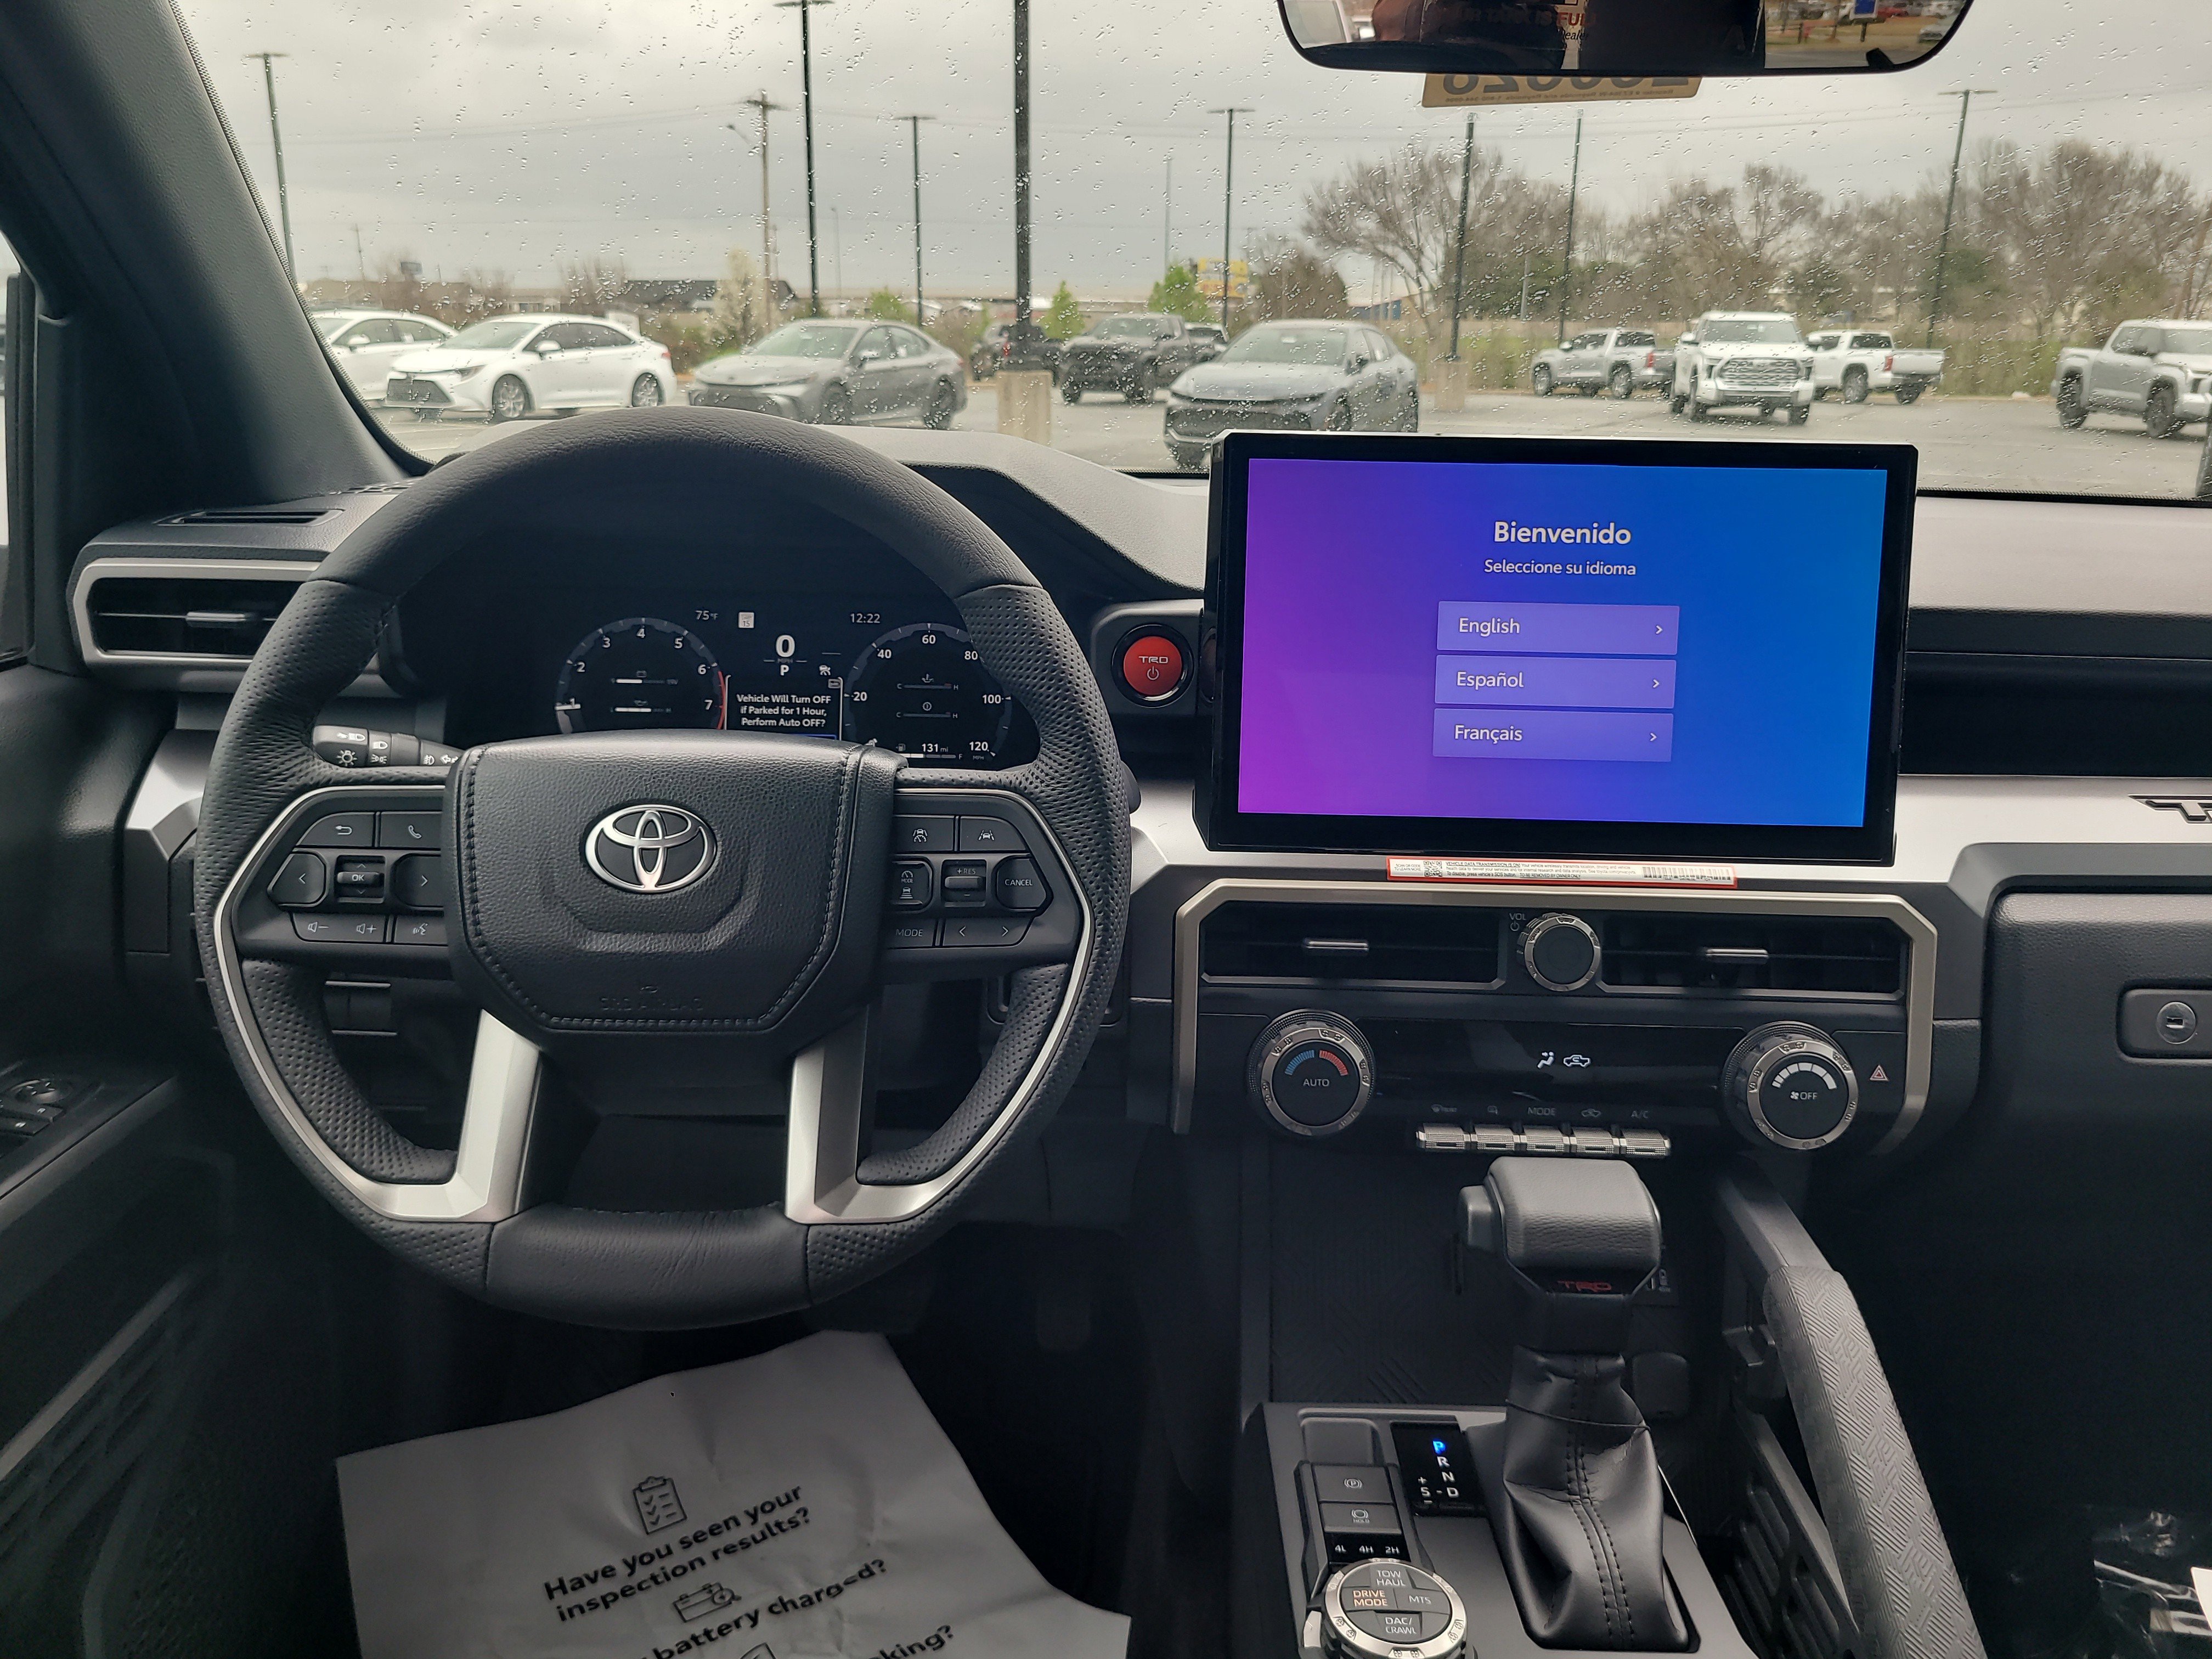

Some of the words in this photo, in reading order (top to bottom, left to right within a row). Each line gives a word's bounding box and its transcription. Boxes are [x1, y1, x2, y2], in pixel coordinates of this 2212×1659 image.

[1493, 521, 1632, 545] Bienvenido
[1483, 559, 1563, 574] Seleccione
[1565, 562, 1583, 575] su
[1585, 561, 1637, 575] idioma
[850, 613, 881, 623] 12:22
[1458, 617, 1521, 637] English
[636, 628, 646, 638] 4
[602, 637, 611, 648] 3
[674, 638, 683, 648] 5
[922, 634, 936, 644] 60
[776, 635, 795, 658] 0
[877, 649, 892, 658] 40
[964, 651, 978, 661] 80
[1138, 656, 1169, 664] TRD
[577, 662, 585, 673] 2
[697, 664, 707, 674] 6
[780, 664, 789, 675] P
[1456, 671, 1525, 690] Español
[736, 694, 770, 703] Vehicle
[771, 694, 789, 703] Will
[791, 695, 811, 703] Turn
[812, 695, 831, 704] OFF
[853, 692, 867, 702] 20
[982, 694, 1001, 704] 100
[704, 699, 713, 710] 7
[740, 706, 748, 714] if
[748, 706, 780, 714] Parked
[781, 706, 794, 714] for
[802, 707, 827, 716] Hour,
[741, 718, 777, 726] Perform
[778, 718, 800, 726] Auto
[802, 719, 826, 727] OFF?
[1454, 724, 1523, 744] Français
[922, 743, 938, 752] 131
[969, 741, 988, 751] 120
[351, 873, 365, 882] OK
[895, 929, 923, 937] MODE
[1303, 1079, 1330, 1087] AUTO
[1800, 1092, 1818, 1101] OFF
[1527, 1107, 1556, 1116] MODE
[1630, 1109, 1650, 1119] A/C
[1557, 1280, 1612, 1292] TRD
[1432, 1440, 1446, 1454] P
[1437, 1456, 1450, 1468] R
[1442, 1471, 1455, 1482] N
[1447, 1487, 1459, 1498] D
[544, 1562, 617, 1601] Have
[622, 1543, 674, 1578] you
[678, 1513, 741, 1550] seen
[744, 1486, 802, 1528] your
[1359, 1545, 1374, 1554] 4H
[556, 1557, 706, 1622] inspection
[712, 1506, 811, 1561] results?
[1378, 1570, 1401, 1578] TOW
[1376, 1578, 1406, 1587] HAUL
[1353, 1589, 1386, 1598] DRIVE
[1353, 1598, 1389, 1607] MODE
[1409, 1595, 1431, 1604] MTS
[1385, 1617, 1412, 1625] DAC/
[653, 1609, 759, 1659] battery
[1386, 1626, 1417, 1634] CRAWL
[868, 1625, 953, 1659] king?
